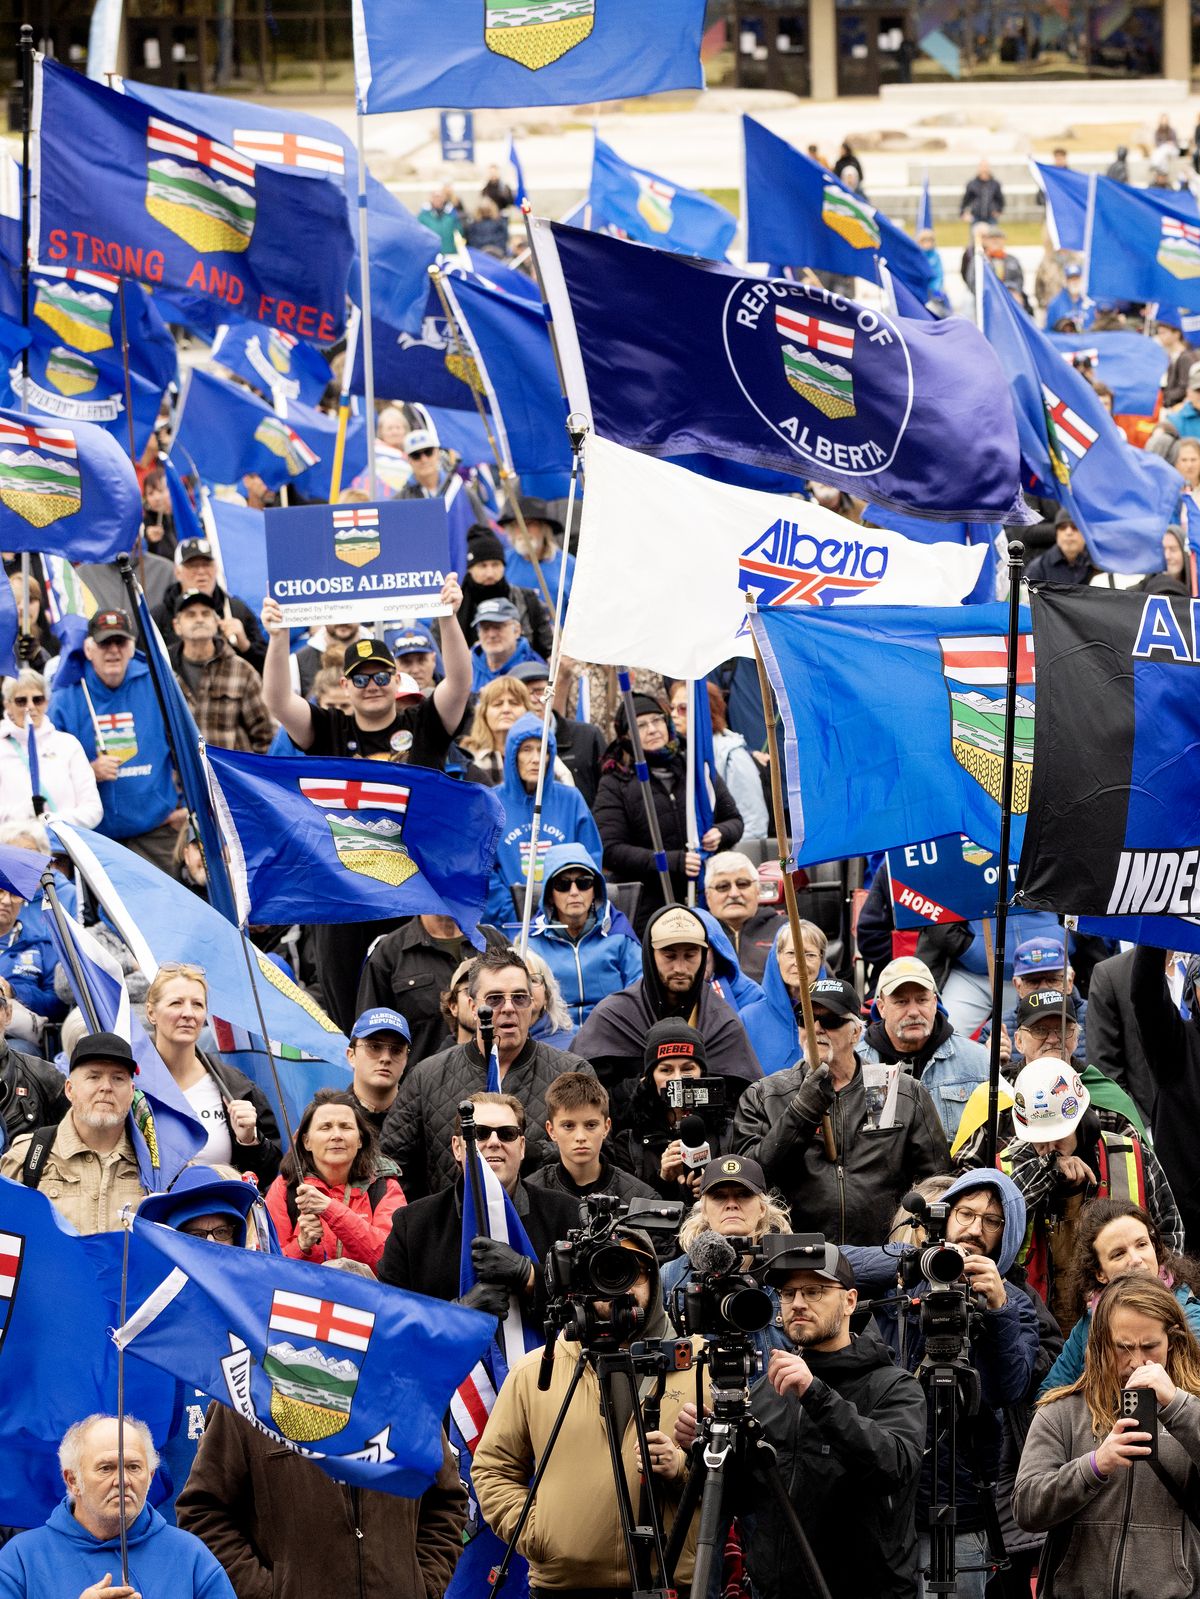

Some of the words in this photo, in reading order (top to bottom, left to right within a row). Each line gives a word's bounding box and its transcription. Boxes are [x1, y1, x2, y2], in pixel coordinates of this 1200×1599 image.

[48, 228, 166, 282] STRONG
[186, 260, 245, 305] AND
[258, 293, 337, 342] FREE
[857, 309, 893, 346] OF
[778, 416, 888, 470] ALBERTA
[740, 517, 890, 580] Alberta
[273, 576, 355, 598] CHOOSE
[357, 570, 446, 592] ALBERTA
[280, 604, 313, 615] uthorized
[504, 827, 523, 846] FOR
[542, 823, 566, 843] LOVE
[899, 887, 944, 923] HOPE
[368, 1018, 404, 1029] REPUBLIC
[370, 1012, 402, 1024] ALBERTA
[659, 1043, 693, 1056] REBEL
[727, 1162, 736, 1172] B
